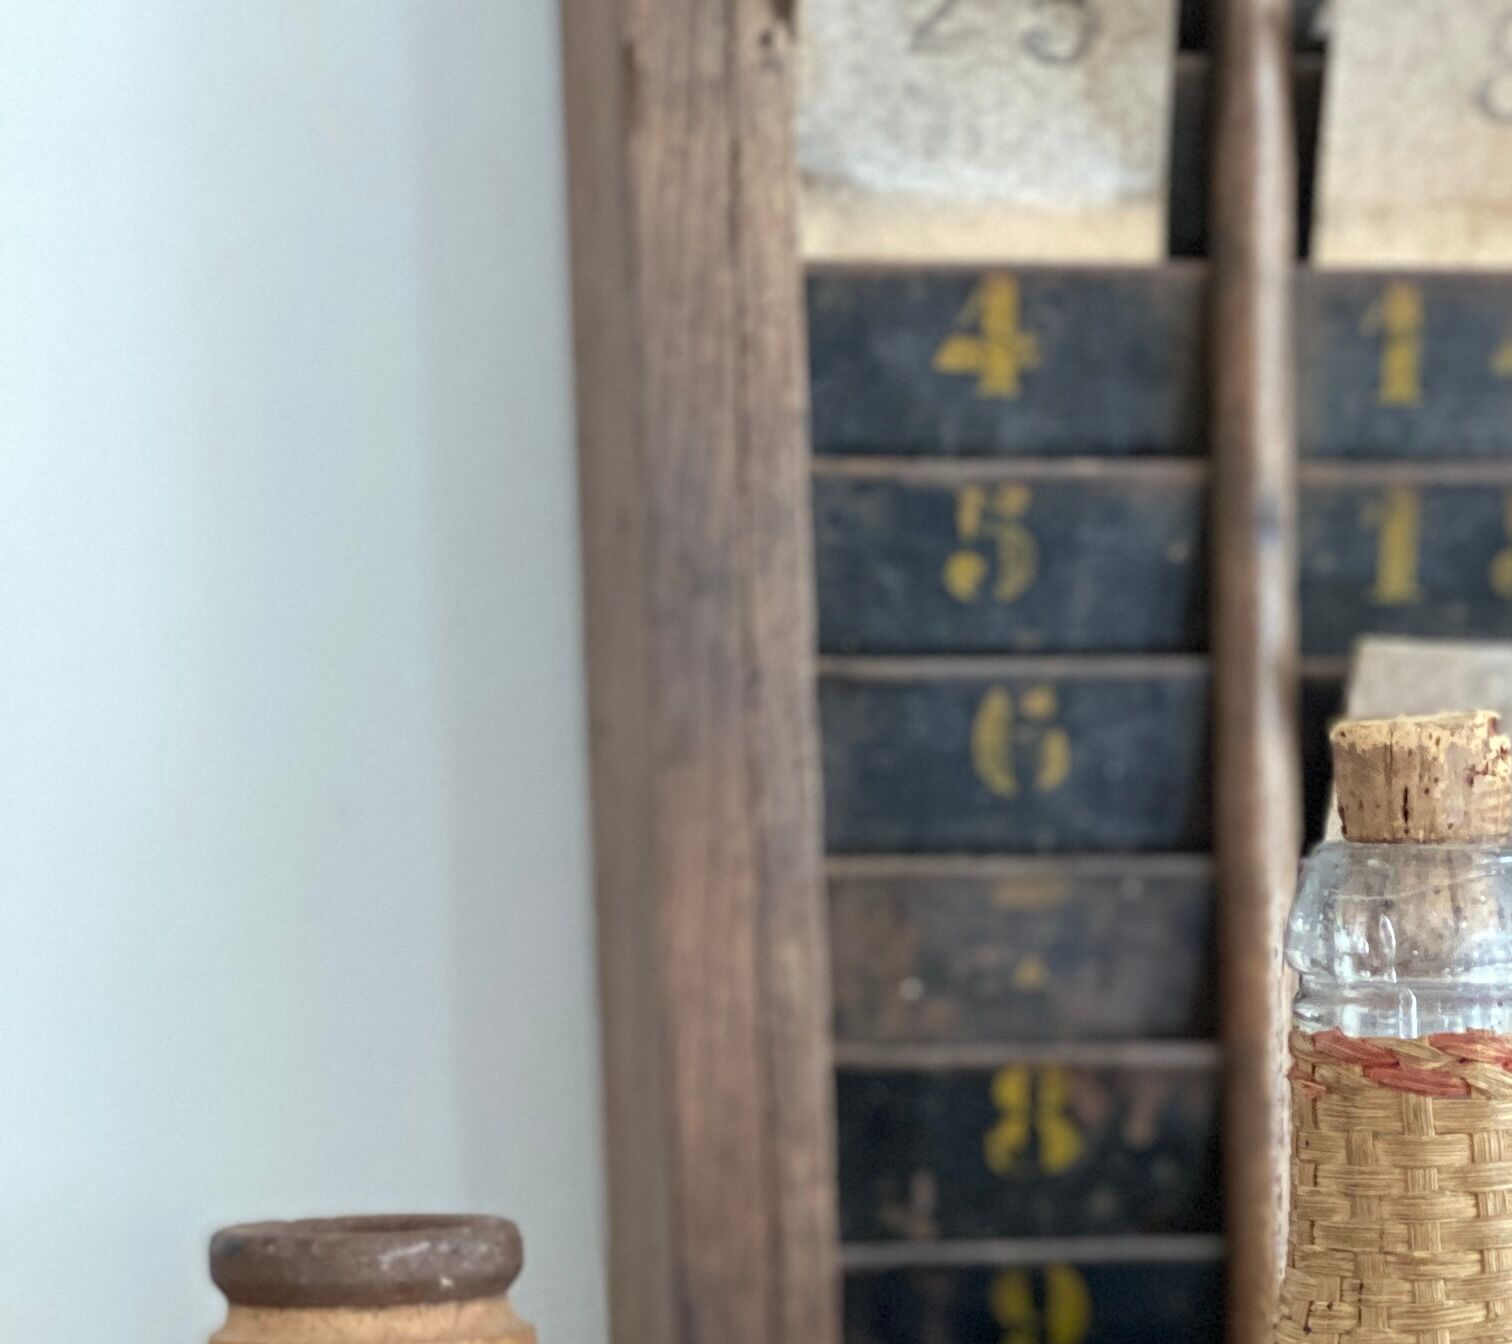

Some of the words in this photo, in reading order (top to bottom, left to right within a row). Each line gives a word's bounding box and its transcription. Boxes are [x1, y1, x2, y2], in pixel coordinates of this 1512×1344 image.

[932, 268, 1045, 398] 4
[944, 484, 1040, 602] 5
[970, 684, 1072, 800] 6
[984, 1064, 1084, 1174] 8
